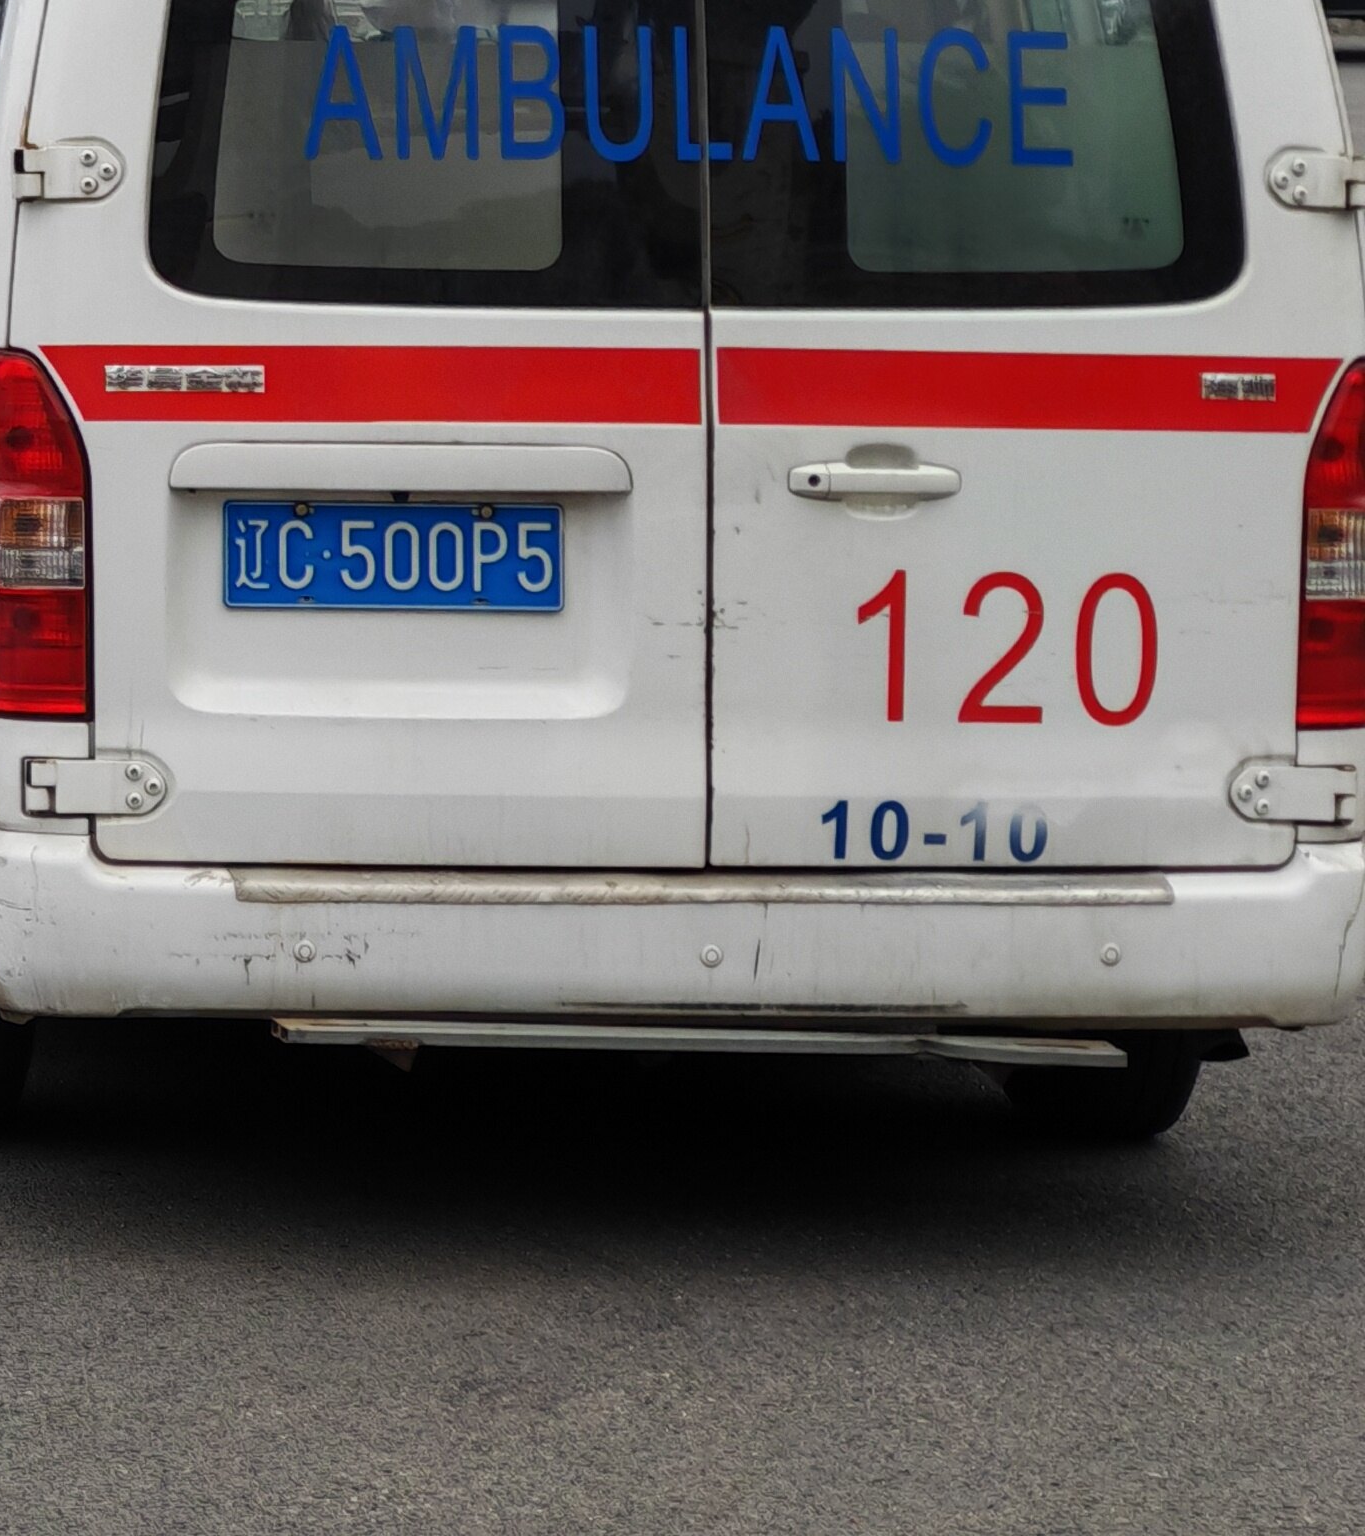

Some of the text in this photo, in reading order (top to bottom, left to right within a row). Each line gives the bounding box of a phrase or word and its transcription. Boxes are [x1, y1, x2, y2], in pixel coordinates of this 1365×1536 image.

[305, 24, 1073, 168] AMBULANCE
[856, 568, 1159, 728] 120
[820, 799, 1050, 865] 10-10
